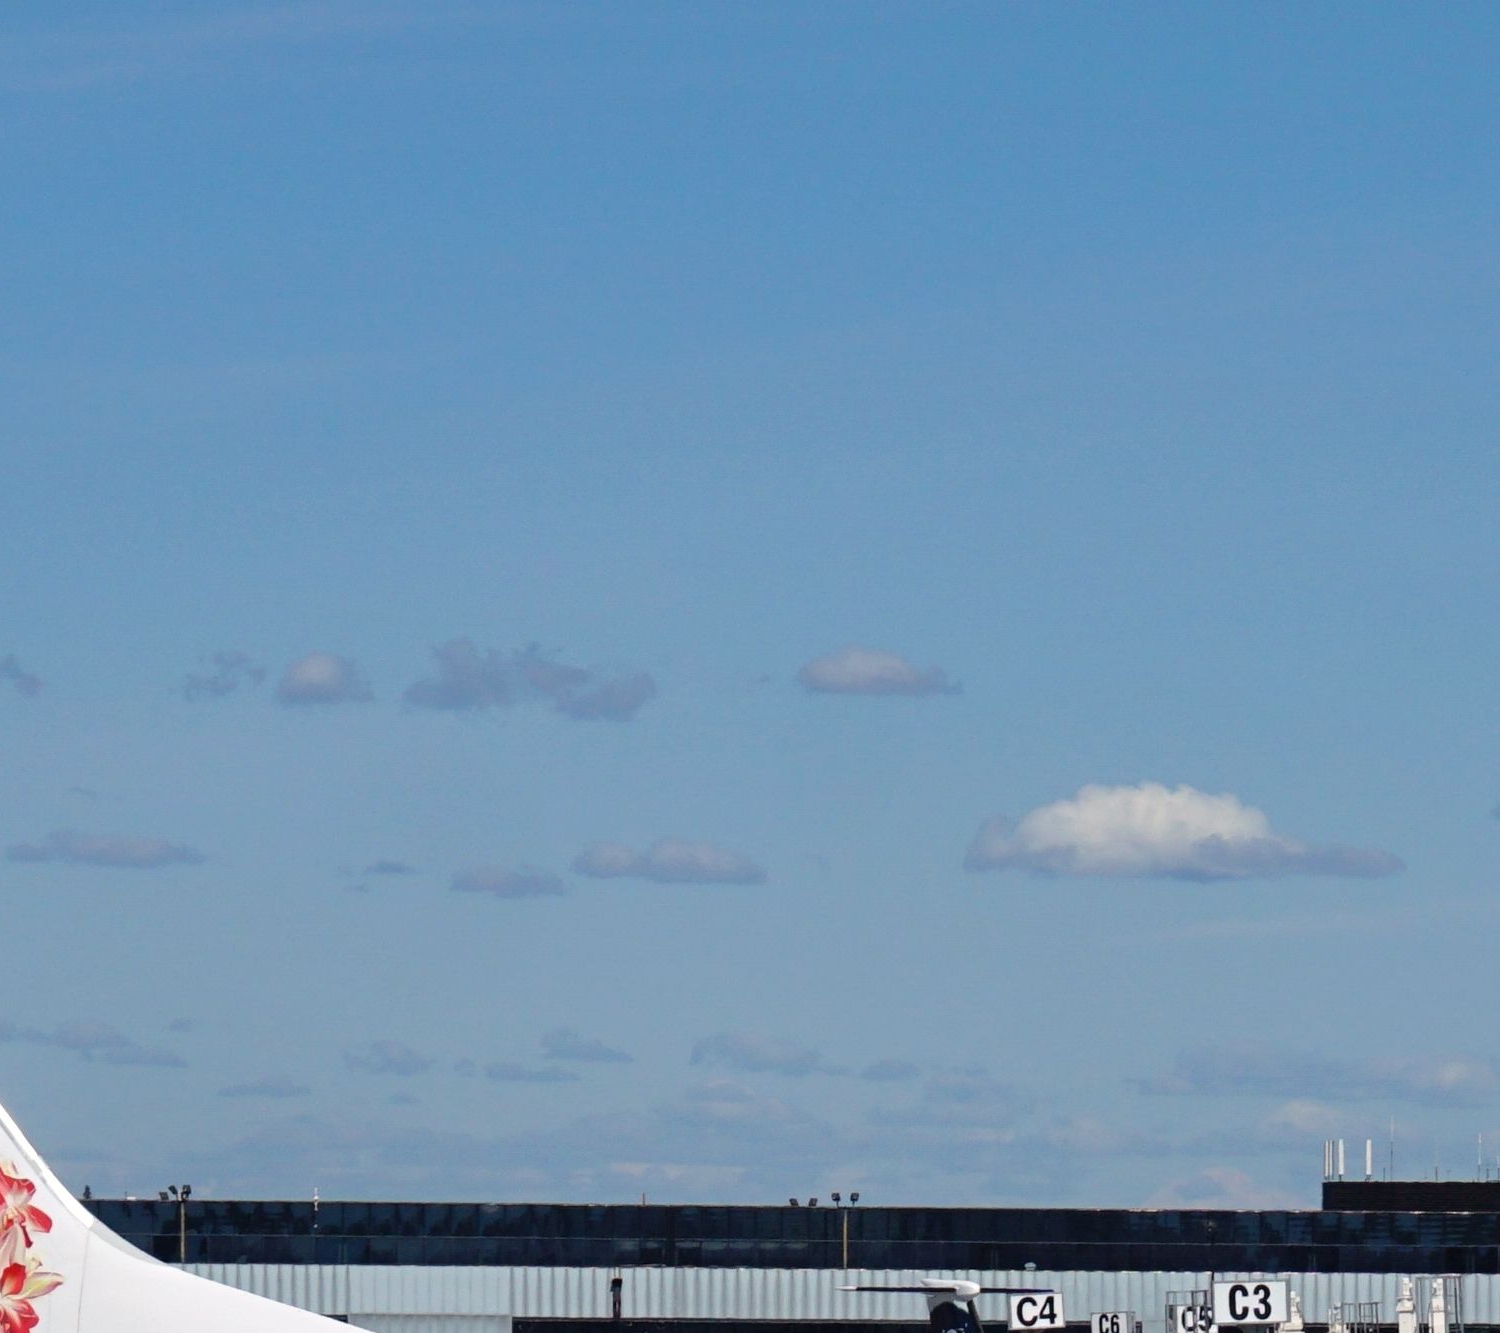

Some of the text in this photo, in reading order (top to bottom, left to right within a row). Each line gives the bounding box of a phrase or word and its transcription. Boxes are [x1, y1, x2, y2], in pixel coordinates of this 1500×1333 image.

[1016, 1295, 1058, 1328] C4
[1181, 1305, 1214, 1333] C5
[1227, 1284, 1272, 1321] C3
